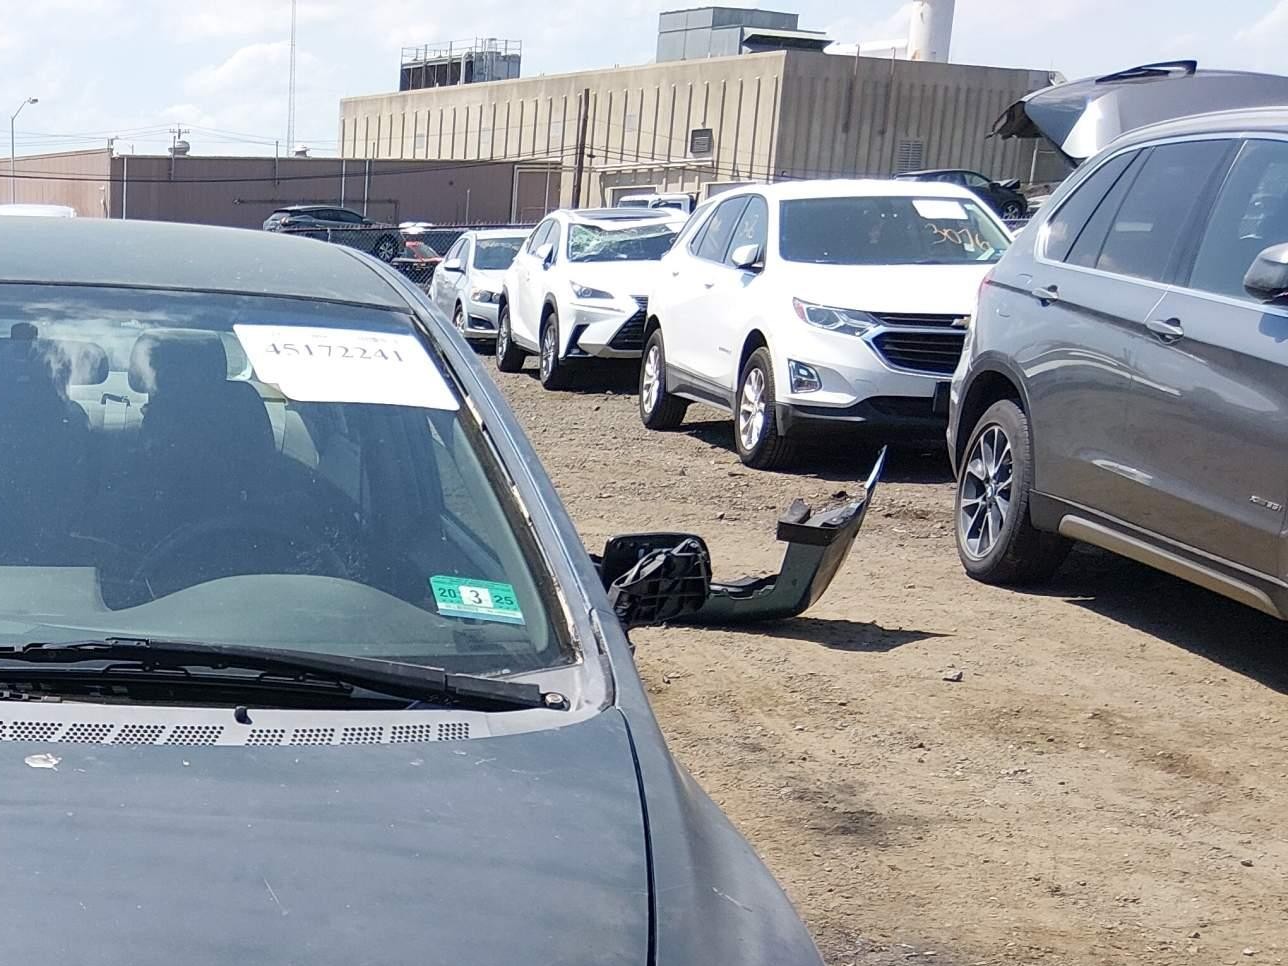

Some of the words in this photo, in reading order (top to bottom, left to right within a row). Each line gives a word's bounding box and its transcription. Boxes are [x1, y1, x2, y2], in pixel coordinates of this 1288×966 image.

[265, 342, 404, 362] 45172241
[438, 587, 458, 599] 20
[469, 589, 483, 605] 3
[494, 594, 514, 606] 25
